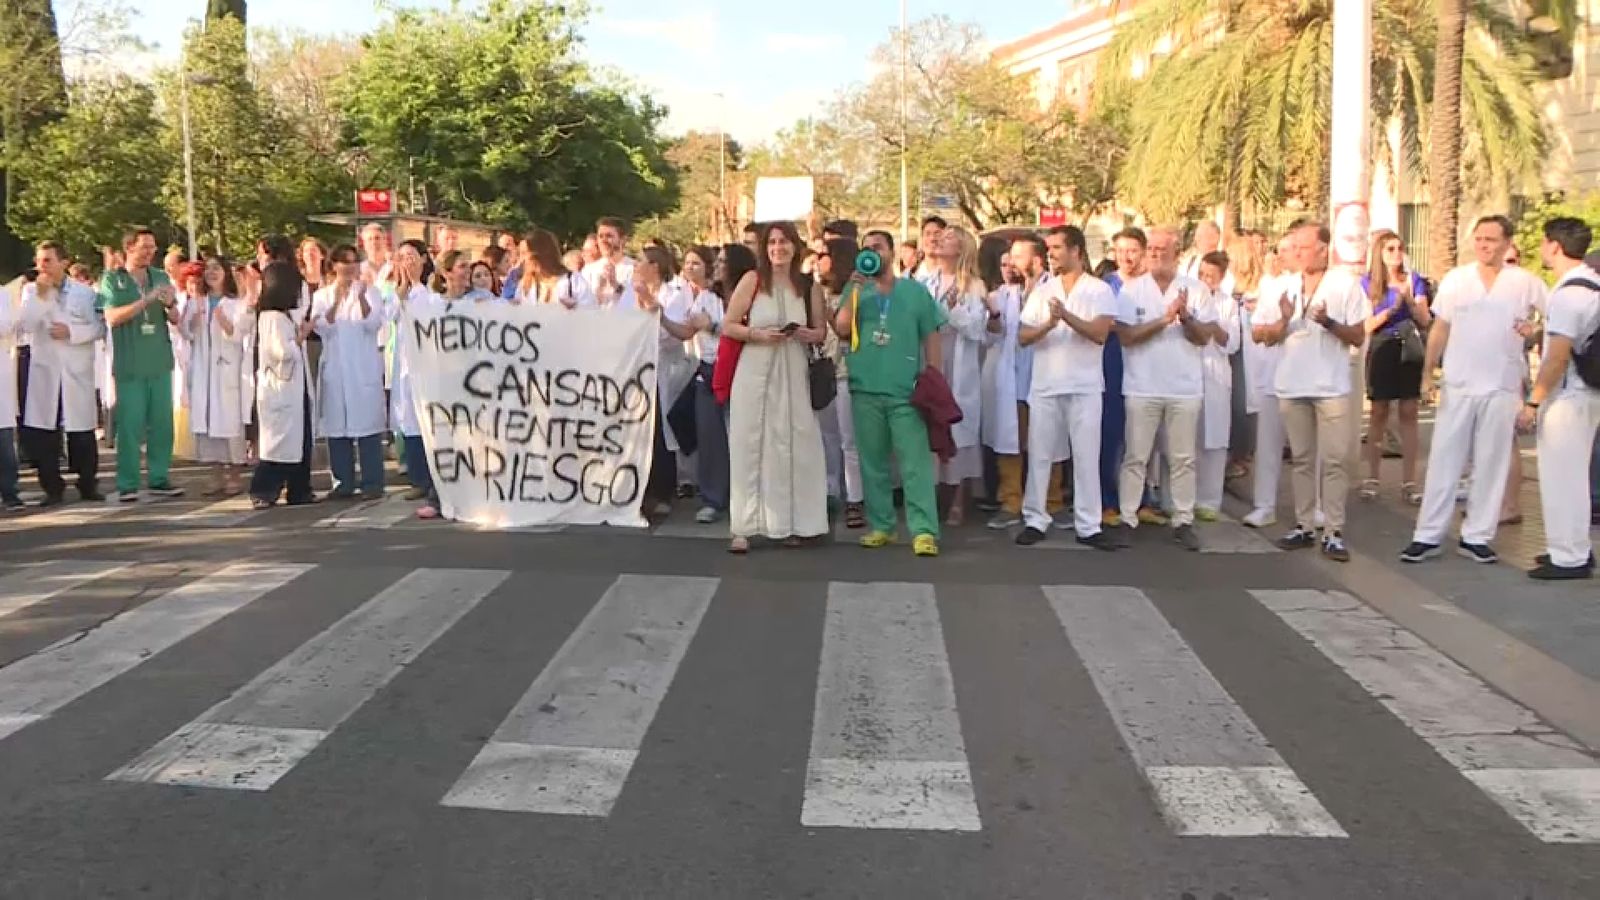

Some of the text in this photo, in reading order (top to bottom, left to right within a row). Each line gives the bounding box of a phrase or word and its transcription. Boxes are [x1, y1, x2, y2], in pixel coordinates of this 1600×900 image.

[414, 303, 541, 362] MÉDICOS
[463, 361, 654, 423] CANSADOS
[427, 402, 623, 455] PACIENTES
[433, 447, 639, 506] EN RIESGO
